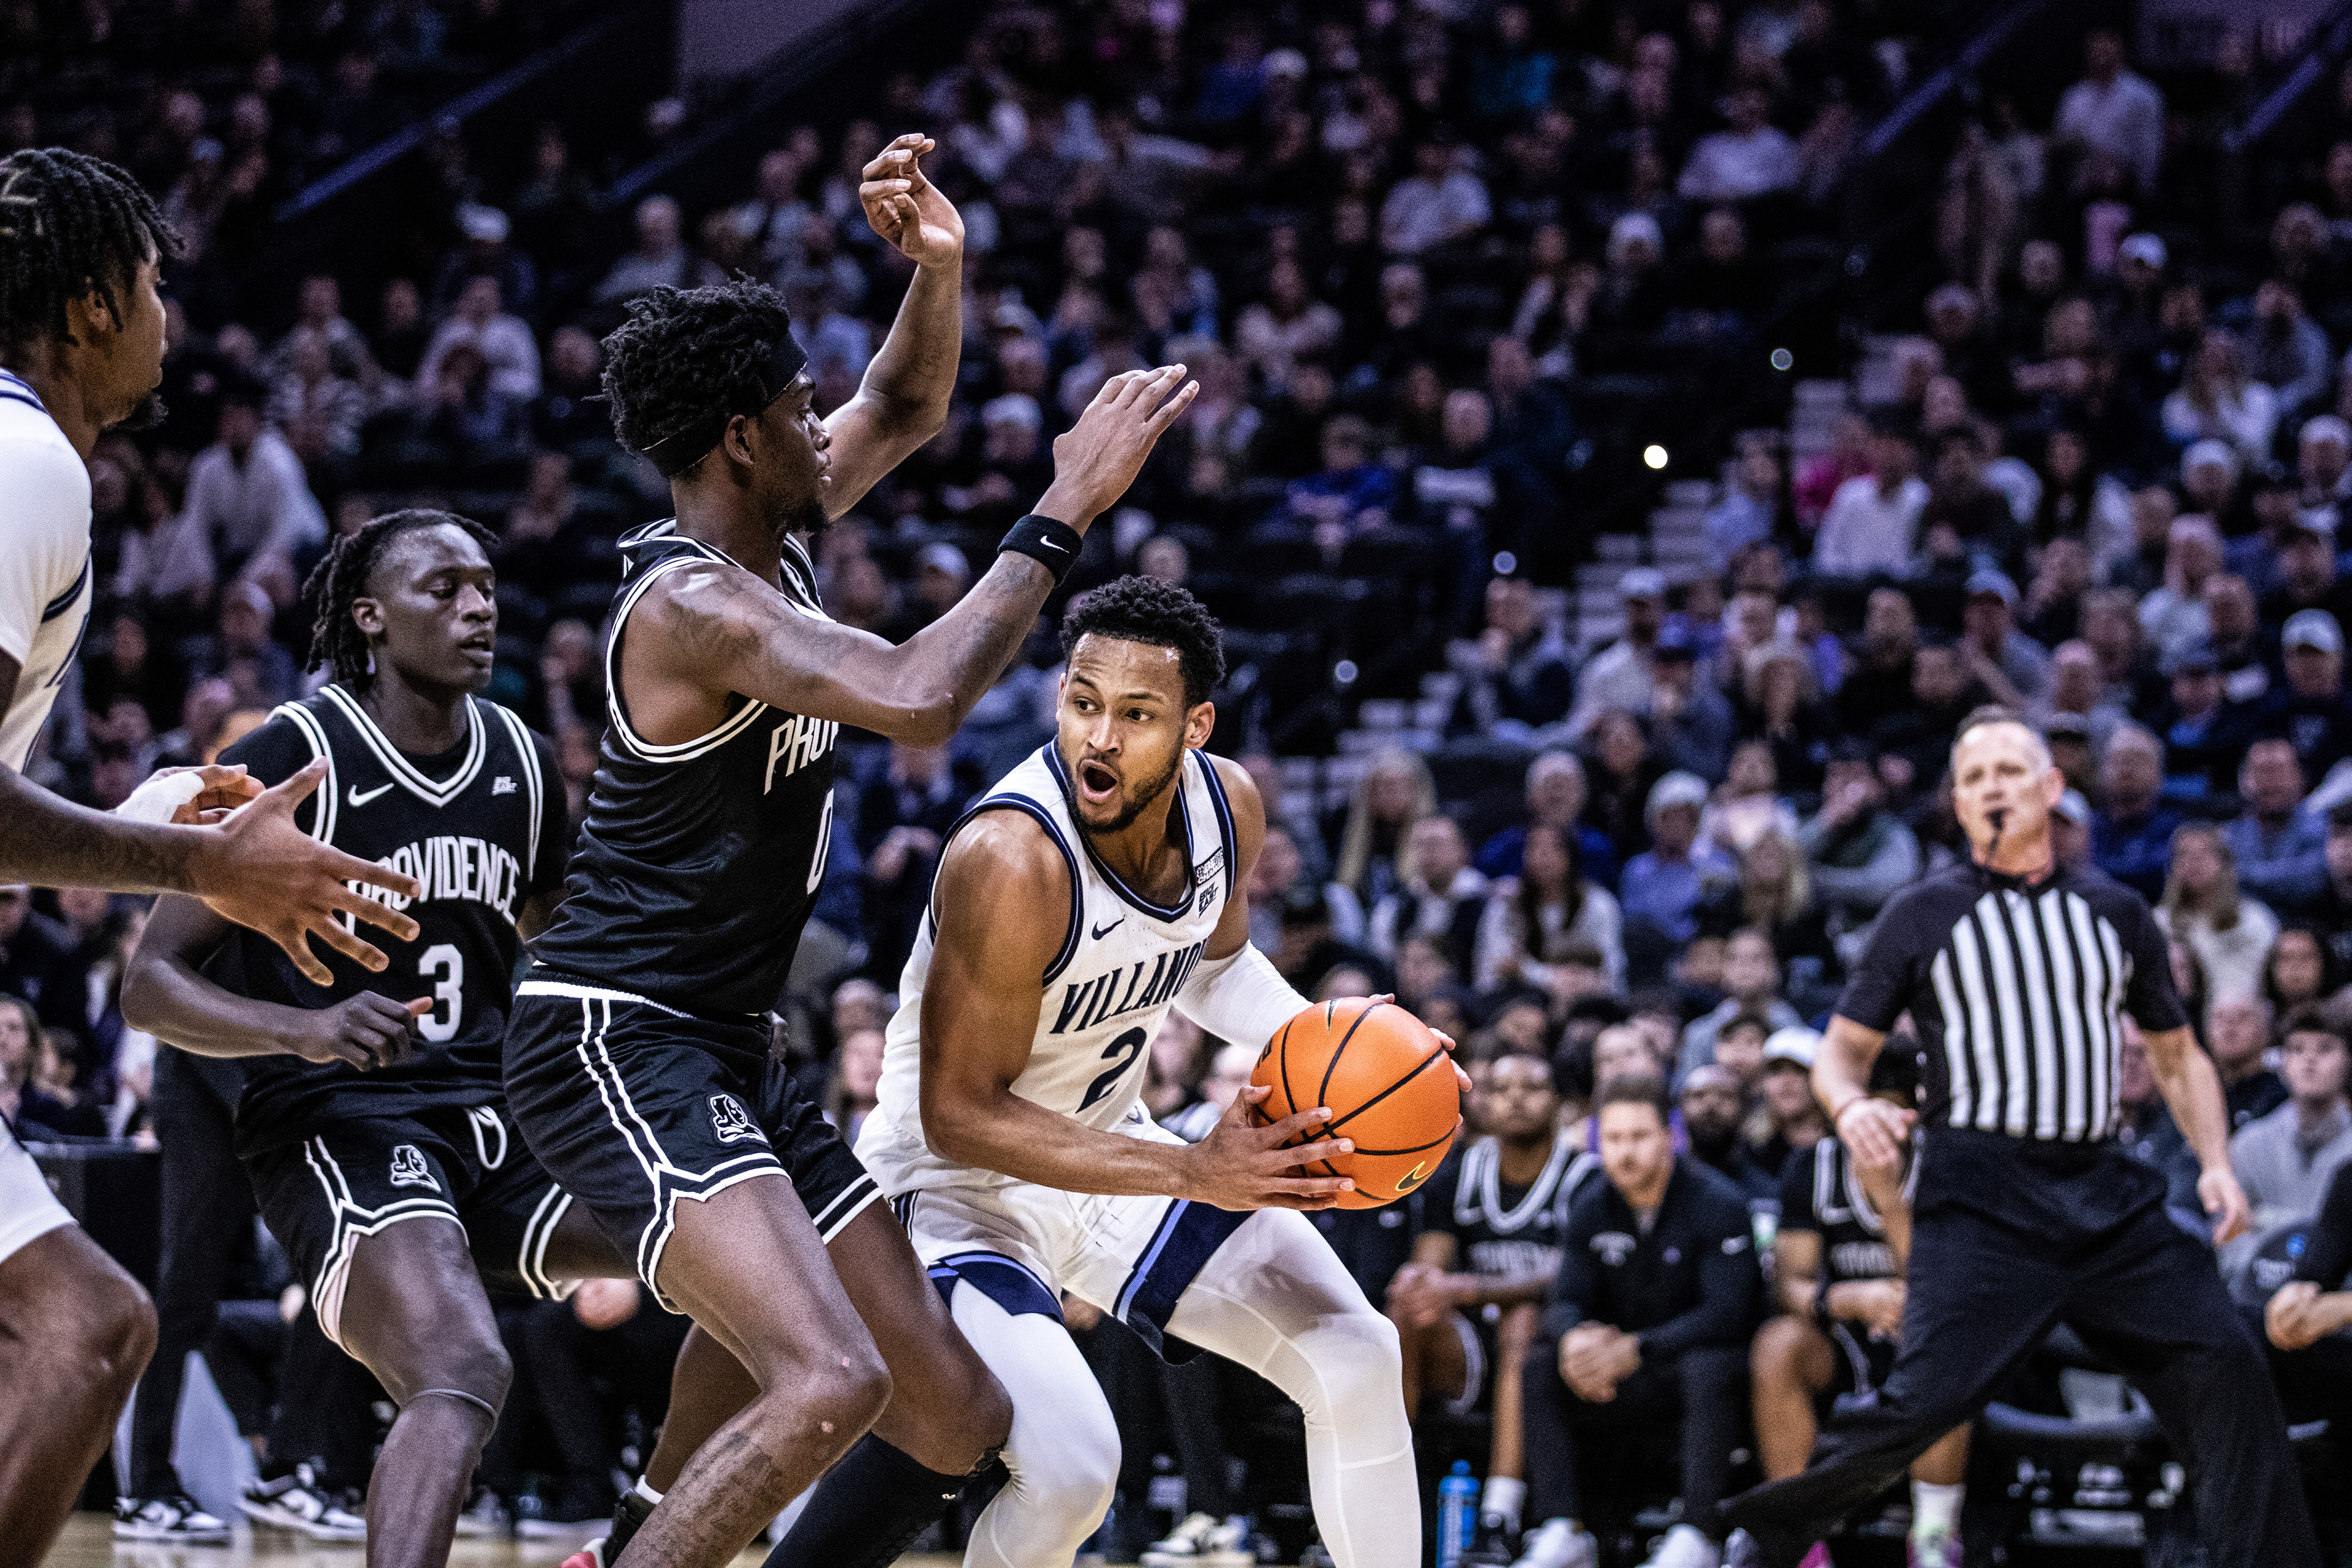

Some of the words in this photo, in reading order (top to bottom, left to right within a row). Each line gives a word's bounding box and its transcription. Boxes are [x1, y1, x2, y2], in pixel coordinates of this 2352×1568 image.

[1199, 882, 1215, 902] BIG
[1199, 887, 1218, 912] EAST
[418, 944, 463, 1041] 3
[1076, 1027, 1147, 1114] 2
